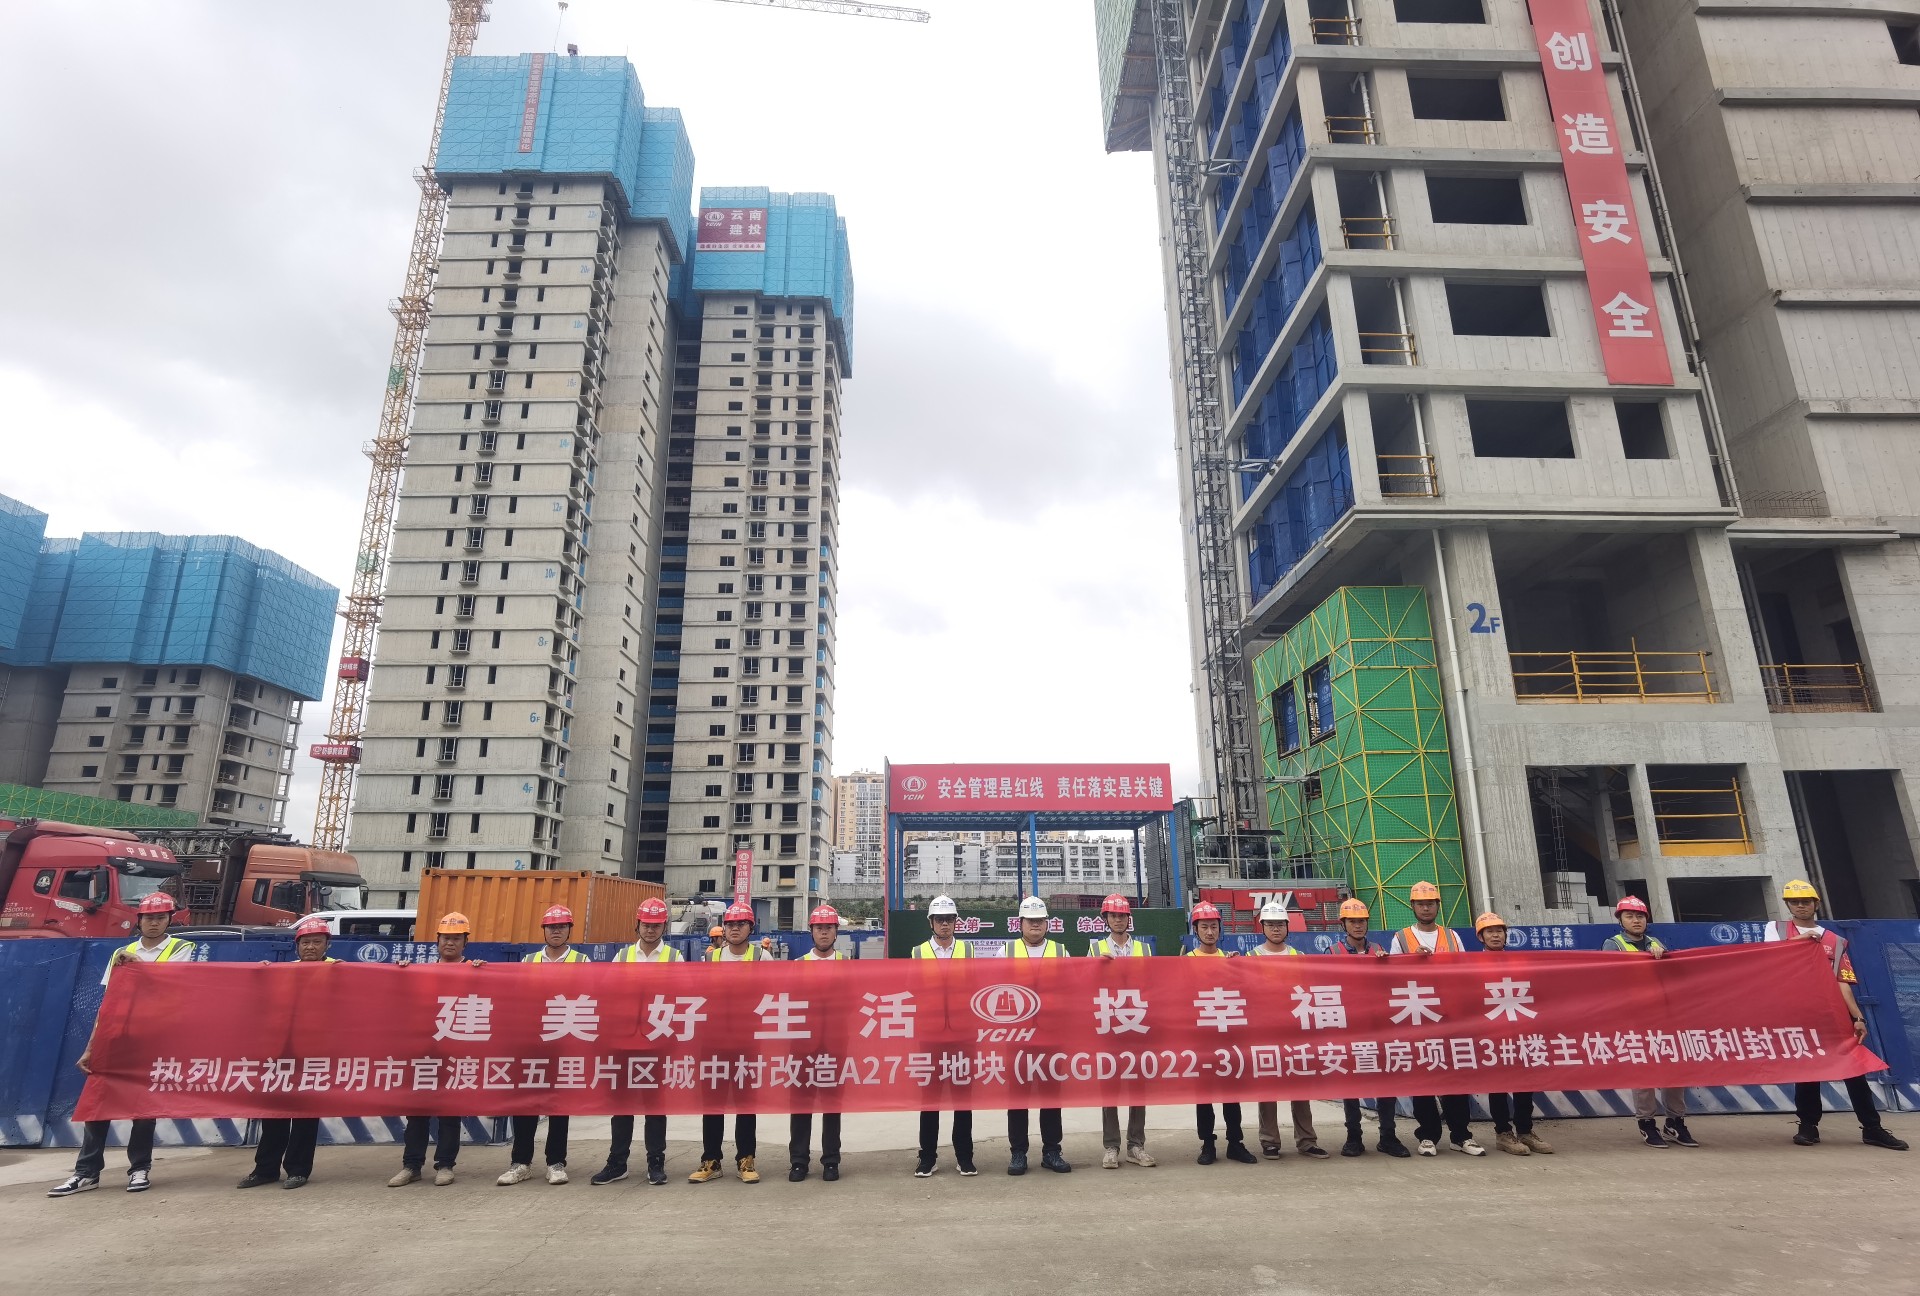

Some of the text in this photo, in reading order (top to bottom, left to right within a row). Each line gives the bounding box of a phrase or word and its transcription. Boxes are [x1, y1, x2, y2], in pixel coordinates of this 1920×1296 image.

[1545, 31, 1654, 338] 创造安全
[730, 210, 763, 221] 云南
[729, 224, 763, 235] 建投
[1466, 602, 1500, 634] 2F
[529, 712, 541, 723] 6F
[522, 782, 533, 793] 4F
[938, 776, 1164, 799] 安全管理是红线 责任落实是关键
[514, 859, 526, 870] 2F
[1529, 927, 1573, 937] 注意安全
[1530, 937, 1574, 948] 禁止拆除
[391, 943, 439, 954] 注意安全
[432, 977, 1539, 1042] 建美好生活 投幸福未来
[975, 1028, 1036, 1042] YCIH
